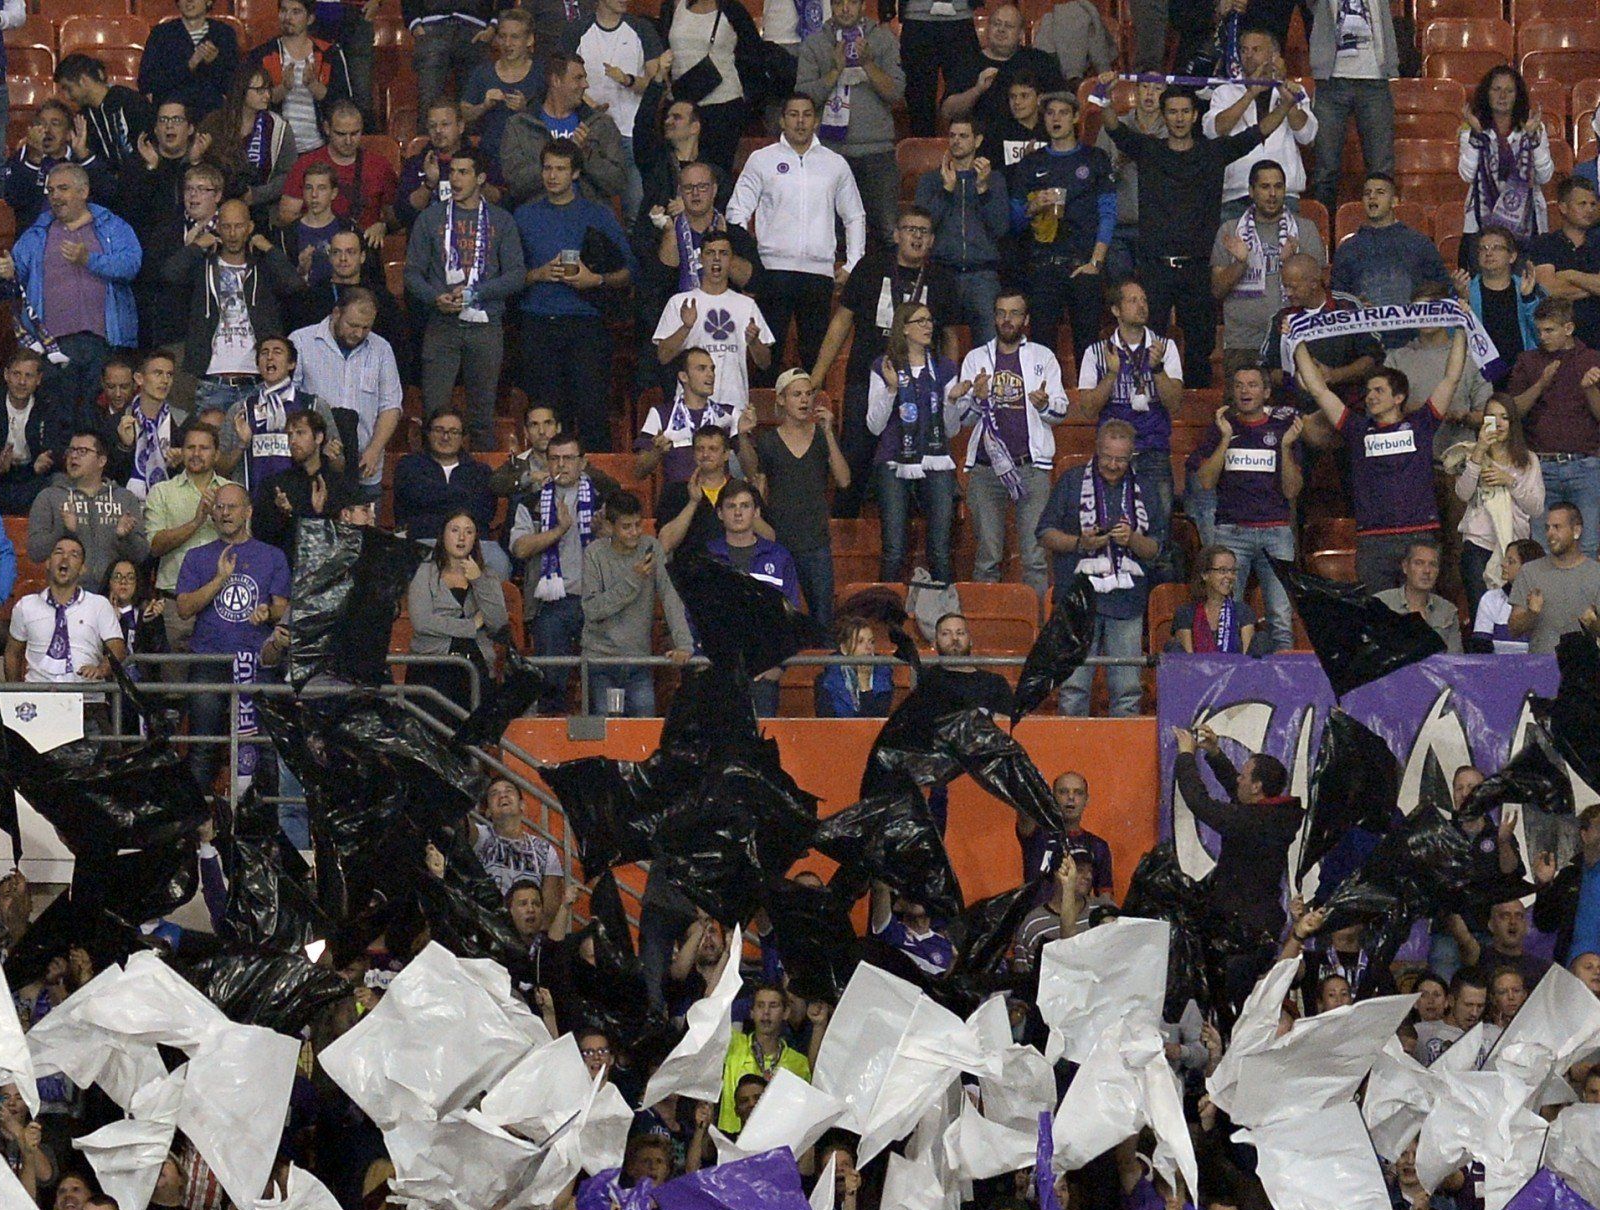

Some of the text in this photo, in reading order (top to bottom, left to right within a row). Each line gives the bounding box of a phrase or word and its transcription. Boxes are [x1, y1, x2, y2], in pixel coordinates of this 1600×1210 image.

[1308, 303, 1455, 329] AUSTRIA WIEN
[1367, 436, 1412, 451] Verbund
[1227, 454, 1273, 467] Verbund
[238, 651, 253, 684] AUS
